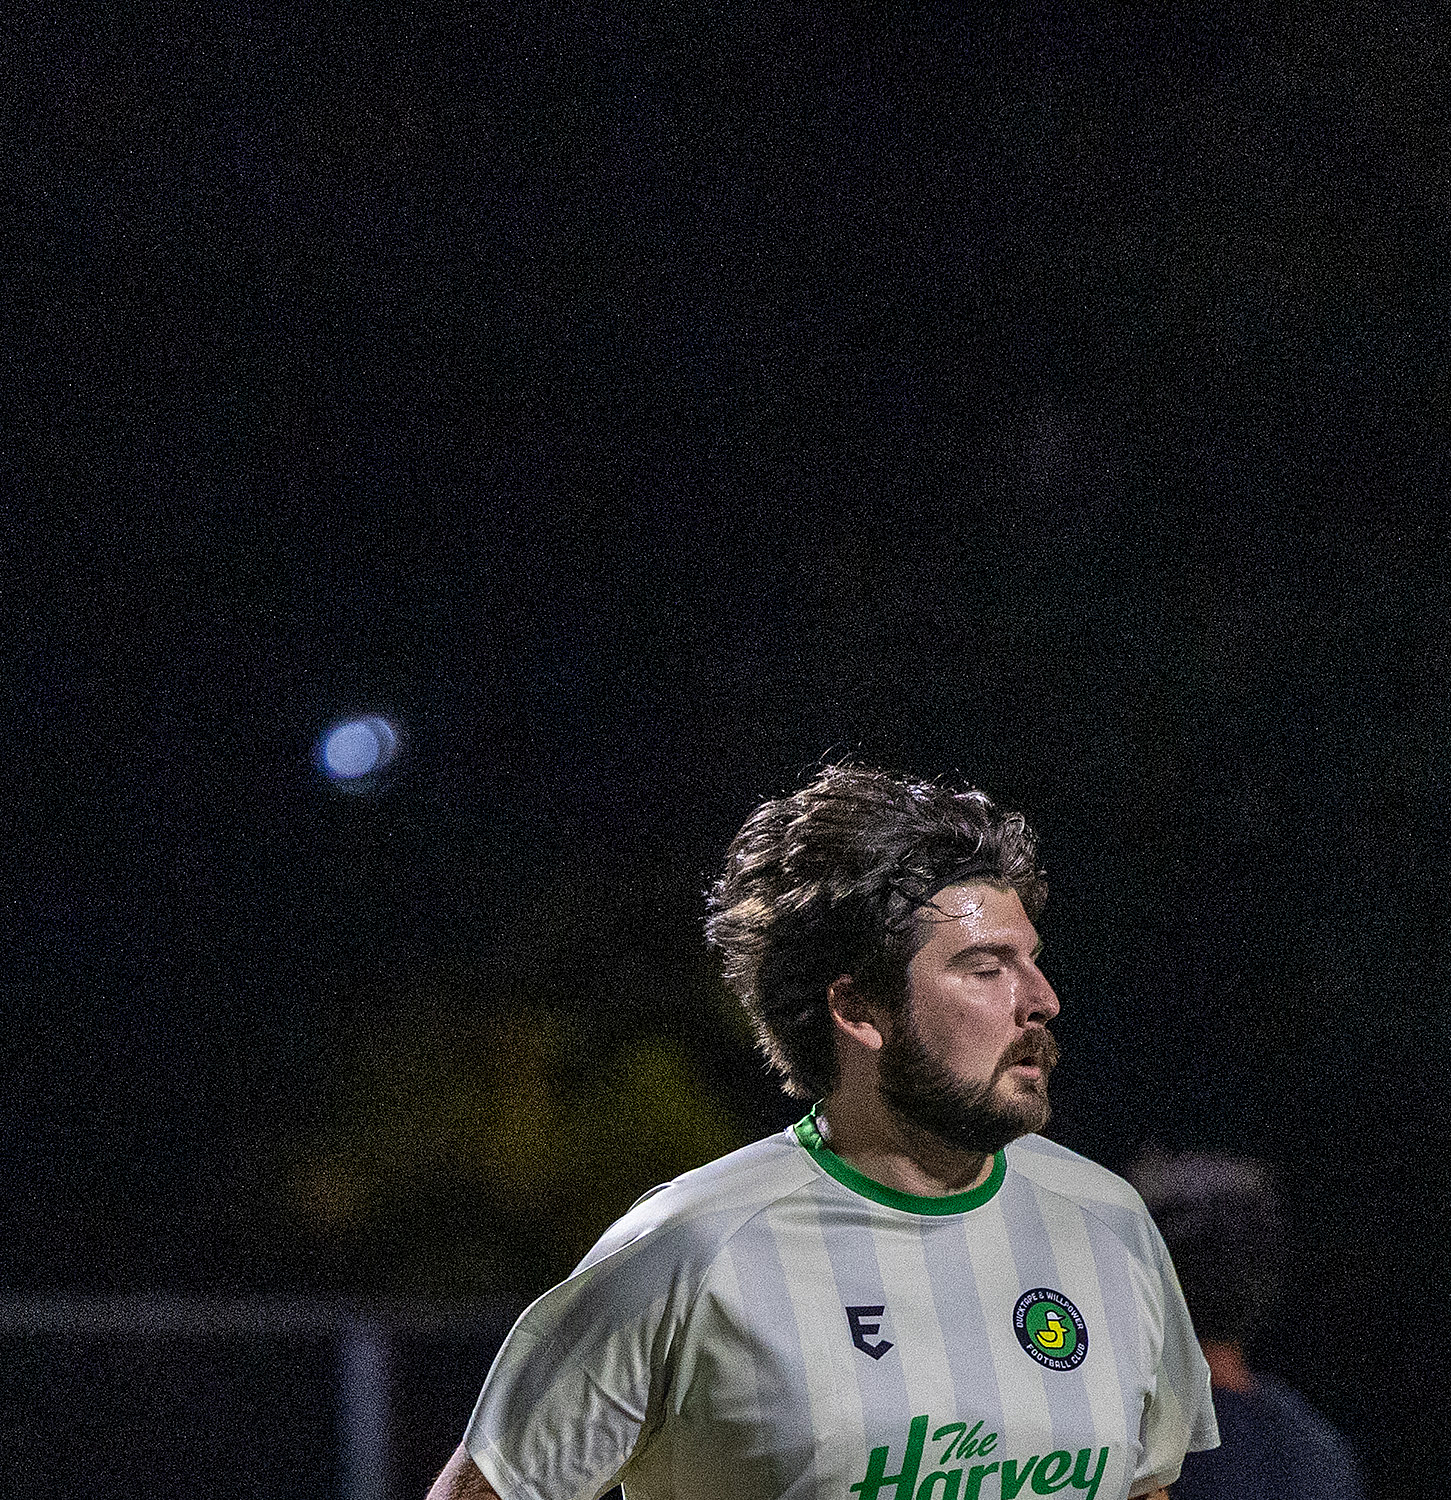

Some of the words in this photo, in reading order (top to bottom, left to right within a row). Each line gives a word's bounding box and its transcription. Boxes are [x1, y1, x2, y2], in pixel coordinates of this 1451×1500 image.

[1046, 1291, 1084, 1330] WILLPOWER
[1026, 1343, 1071, 1369] FOOTBALL
[1071, 1342, 1085, 1364] CLUB
[932, 1420, 998, 1465] The
